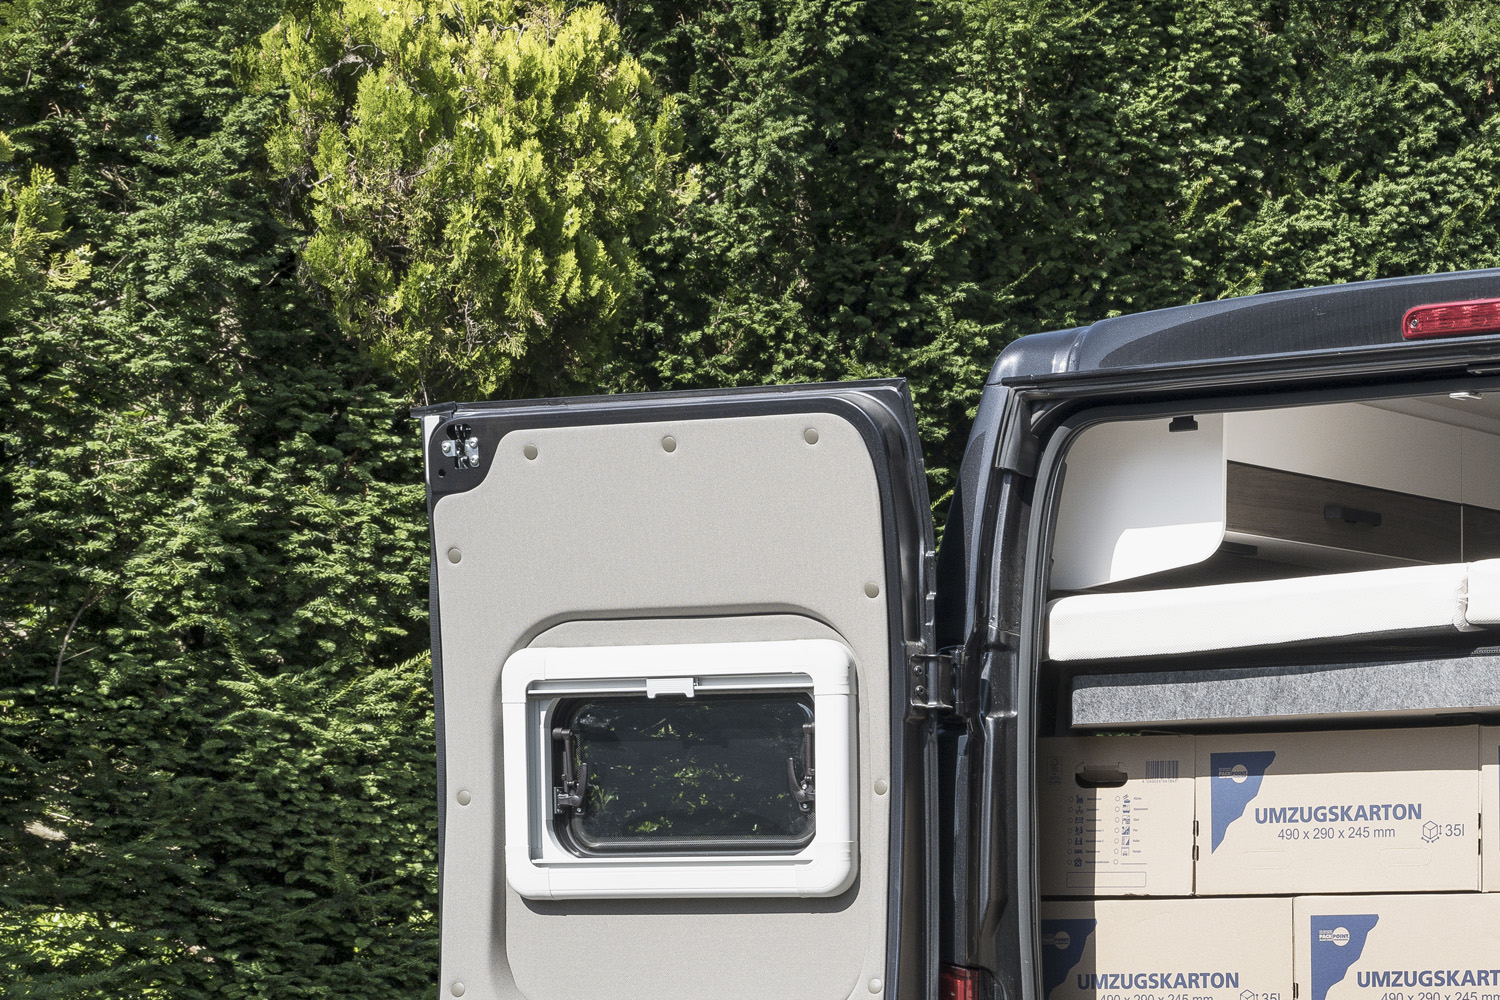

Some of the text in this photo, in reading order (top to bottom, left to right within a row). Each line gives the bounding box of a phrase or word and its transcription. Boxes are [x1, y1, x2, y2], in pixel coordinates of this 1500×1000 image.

[1255, 804, 1421, 824] UMZUGSKARTON
[1278, 826, 1395, 840] 490 x 290 x 245 mm
[1077, 972, 1238, 990] UMZUGSKARTON
